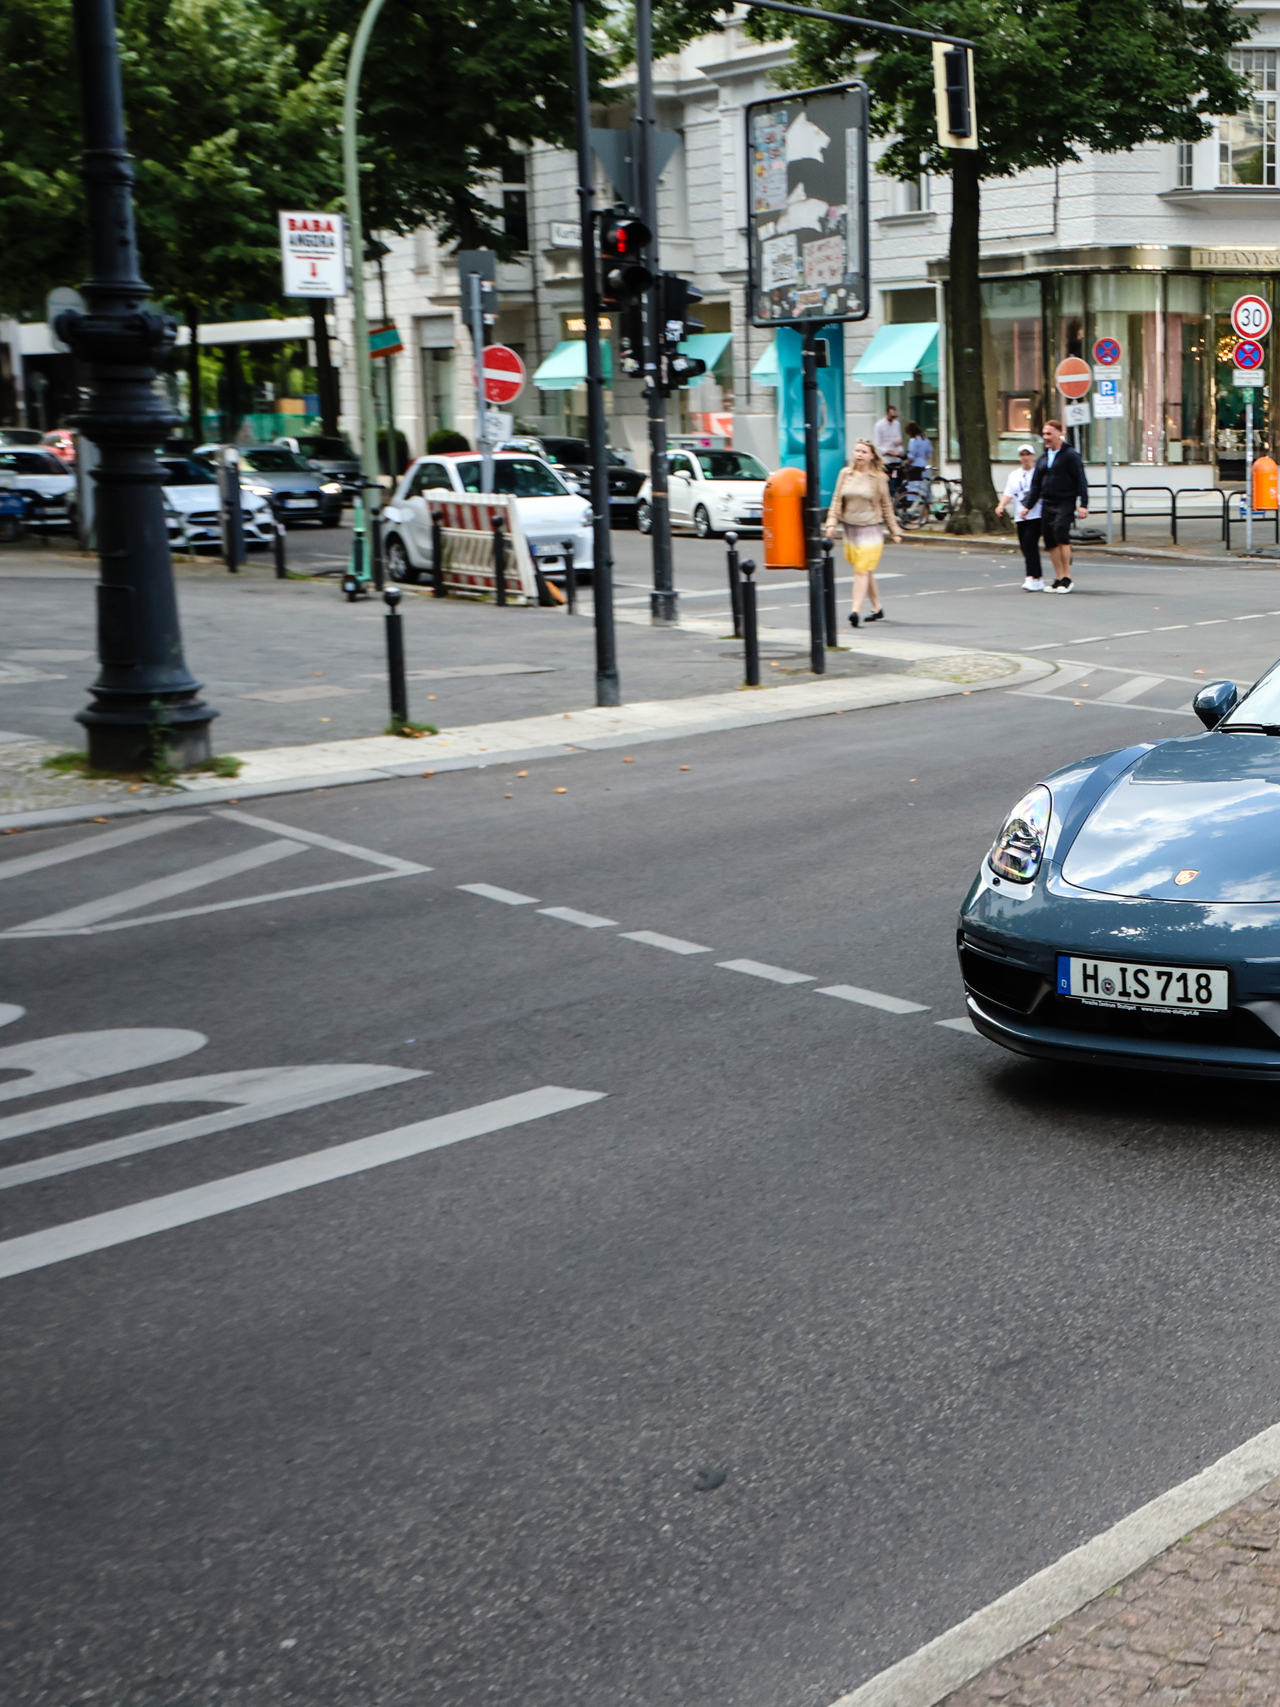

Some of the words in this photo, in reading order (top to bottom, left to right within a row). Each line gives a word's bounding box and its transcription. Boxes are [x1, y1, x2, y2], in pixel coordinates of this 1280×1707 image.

[287, 218, 335, 233] BABA
[1241, 308, 1262, 327] 30
[1101, 382, 1113, 395] P
[1082, 962, 1099, 994] H
[1156, 970, 1212, 1004] 718
